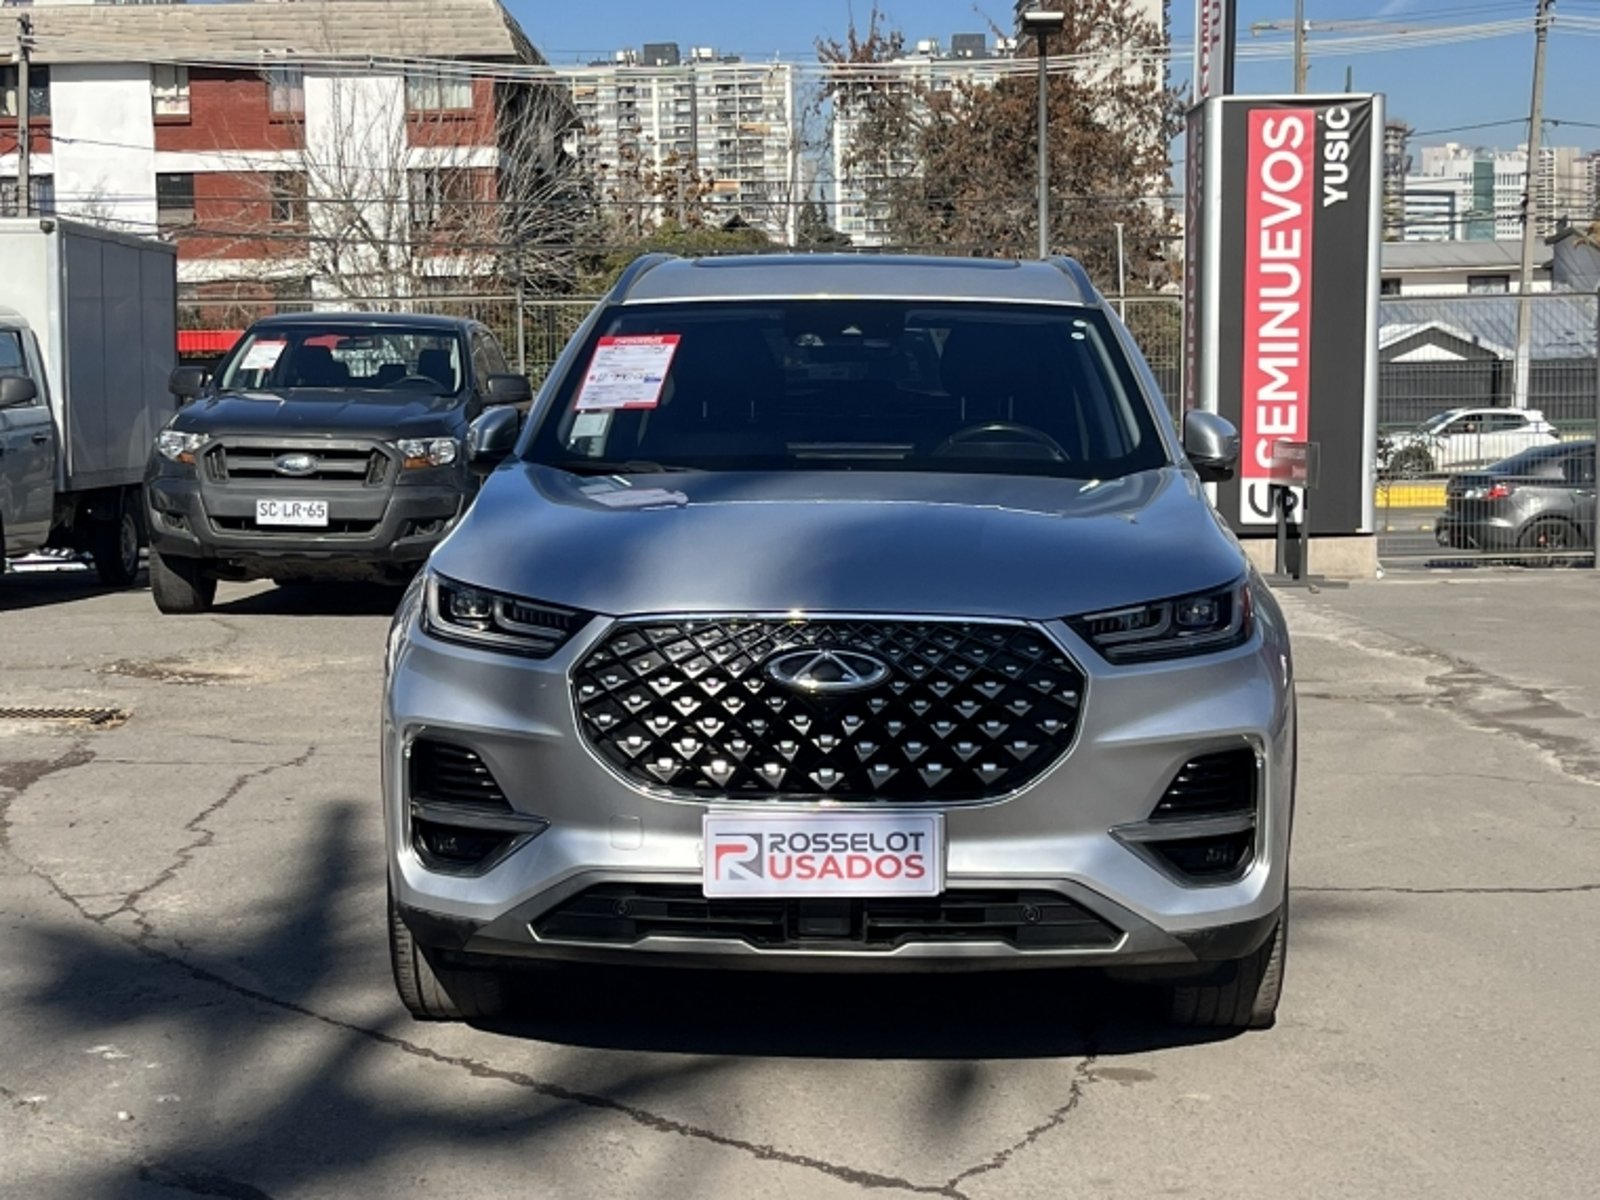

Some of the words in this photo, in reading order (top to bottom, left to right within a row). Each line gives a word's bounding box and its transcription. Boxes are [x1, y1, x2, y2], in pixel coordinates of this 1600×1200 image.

[1318, 107, 1350, 208] YUSIĆ
[1255, 115, 1304, 469] SEMINUEVOS
[260, 502, 277, 517] SC
[768, 832, 925, 853] ROSSELOT
[768, 854, 925, 880] USADOS
